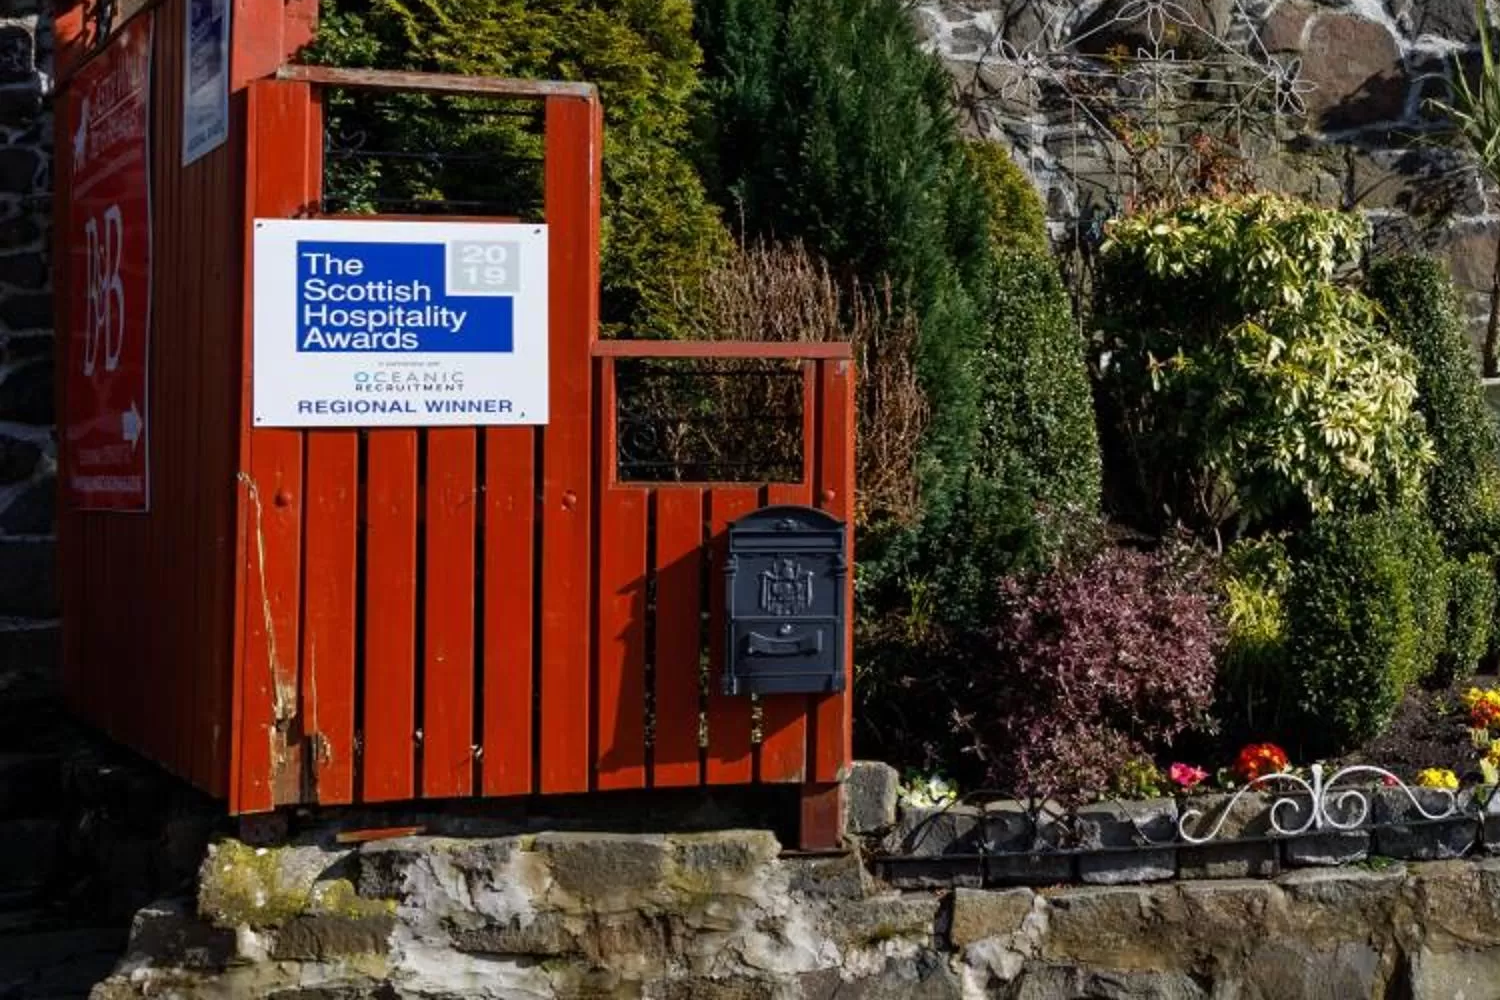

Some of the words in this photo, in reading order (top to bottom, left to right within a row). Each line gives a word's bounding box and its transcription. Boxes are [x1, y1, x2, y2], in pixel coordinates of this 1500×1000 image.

[301, 252, 364, 276] The
[461, 244, 508, 266] 20
[461, 266, 508, 286] 19
[302, 278, 431, 302] Scottish
[303, 303, 468, 332] Hospitality
[302, 327, 420, 349] Awards
[353, 371, 465, 383] OCEANIC
[354, 383, 465, 392] RECRUITMENT
[297, 399, 417, 414] REGIONAL
[424, 399, 514, 413] WINNER
